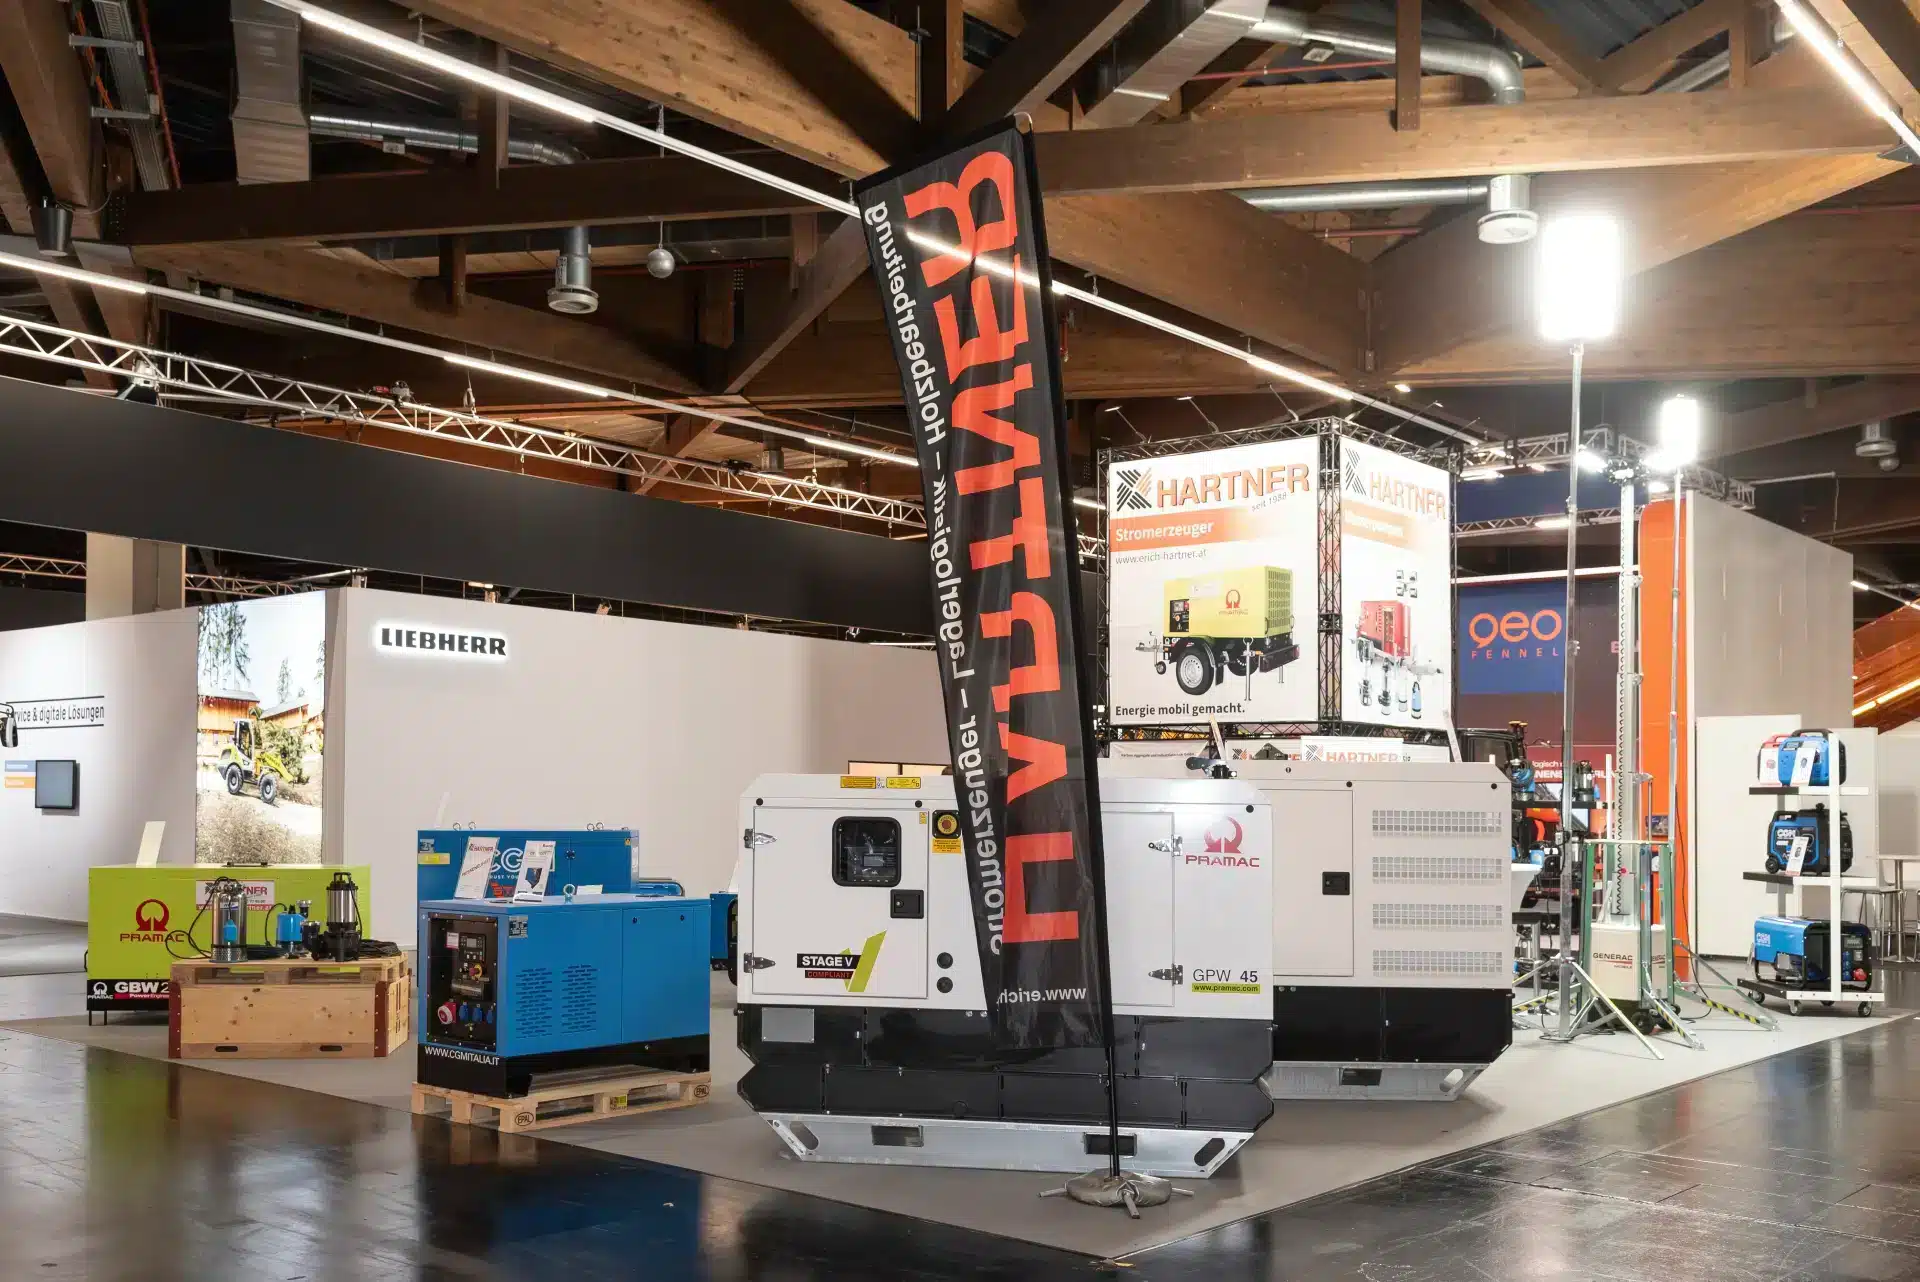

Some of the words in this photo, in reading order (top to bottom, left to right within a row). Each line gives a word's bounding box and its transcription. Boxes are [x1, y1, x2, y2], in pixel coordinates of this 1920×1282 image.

[1156, 463, 1310, 508] HARTNER
[1369, 471, 1446, 520] HARTNER
[1115, 521, 1214, 542] Stromerzeuger
[1115, 549, 1207, 565] www.erich-hartner.at
[1468, 609, 1562, 649] geo
[381, 627, 506, 656] LIEBHERR
[1471, 647, 1559, 660] FENNEL
[6, 707, 31, 723] Srvice
[40, 704, 67, 724] digitale
[68, 704, 105, 723] Lösungen
[1115, 704, 1155, 718] Energie
[1158, 703, 1190, 715] mobil
[1192, 702, 1246, 717] gemacht.
[1185, 854, 1260, 868] PRAMAC
[119, 933, 185, 943] PRAMAC
[801, 955, 843, 967] STAGE
[844, 956, 853, 967] V
[1592, 952, 1633, 961] GENERAC
[1193, 968, 1231, 982] GPW
[1240, 970, 1258, 983] 45
[1193, 984, 1259, 993] www.pramac.com
[424, 1046, 500, 1067] WWW.CGMITALIA.IT
[517, 1113, 533, 1124] EPAL
